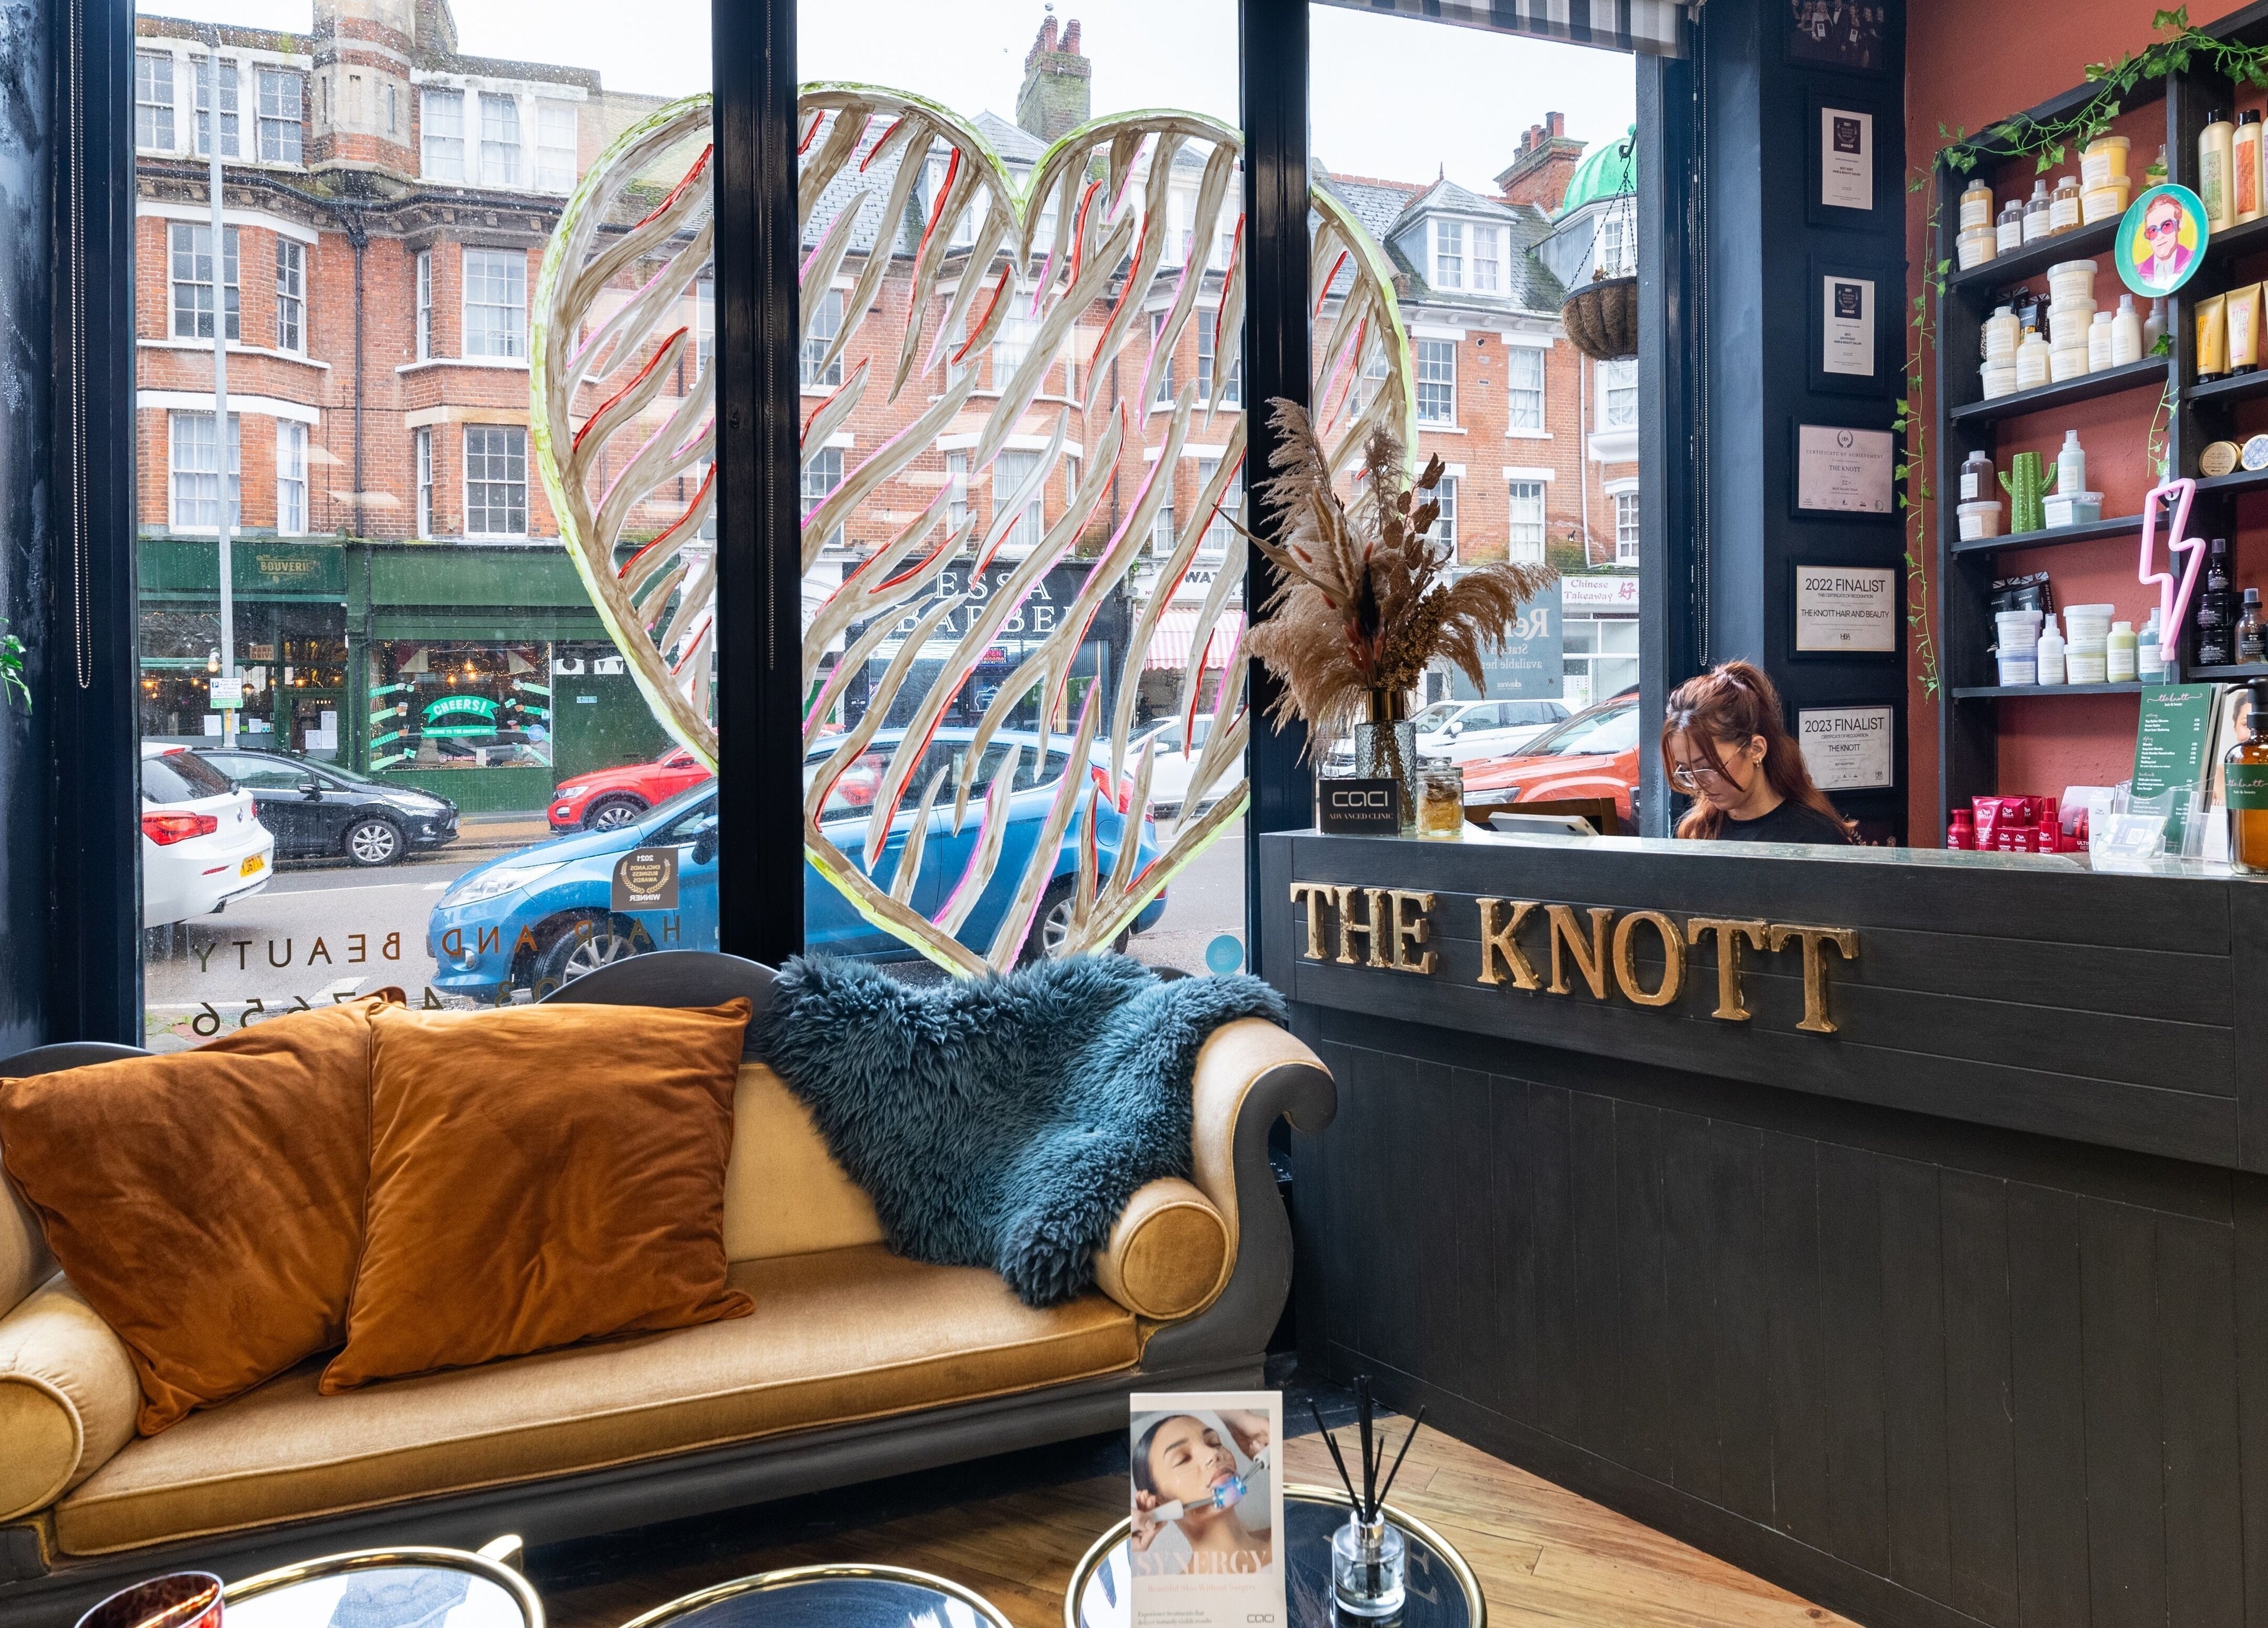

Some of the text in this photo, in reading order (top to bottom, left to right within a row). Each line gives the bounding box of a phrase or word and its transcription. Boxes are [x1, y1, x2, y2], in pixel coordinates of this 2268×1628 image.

[261, 562, 312, 572] BOUVERIE
[1570, 579, 1608, 588] Chinese
[1806, 578, 1885, 592] 2022 FINALIST
[1564, 591, 1613, 601] Takeaway
[433, 699, 487, 715] CHEERS!
[1805, 717, 1885, 732] 2023 FINALIST
[1289, 882, 1859, 1033] THE KNOTT
[1136, 1550, 1267, 1575] SYNERGY
[1229, 1584, 1256, 1593] Surgery
